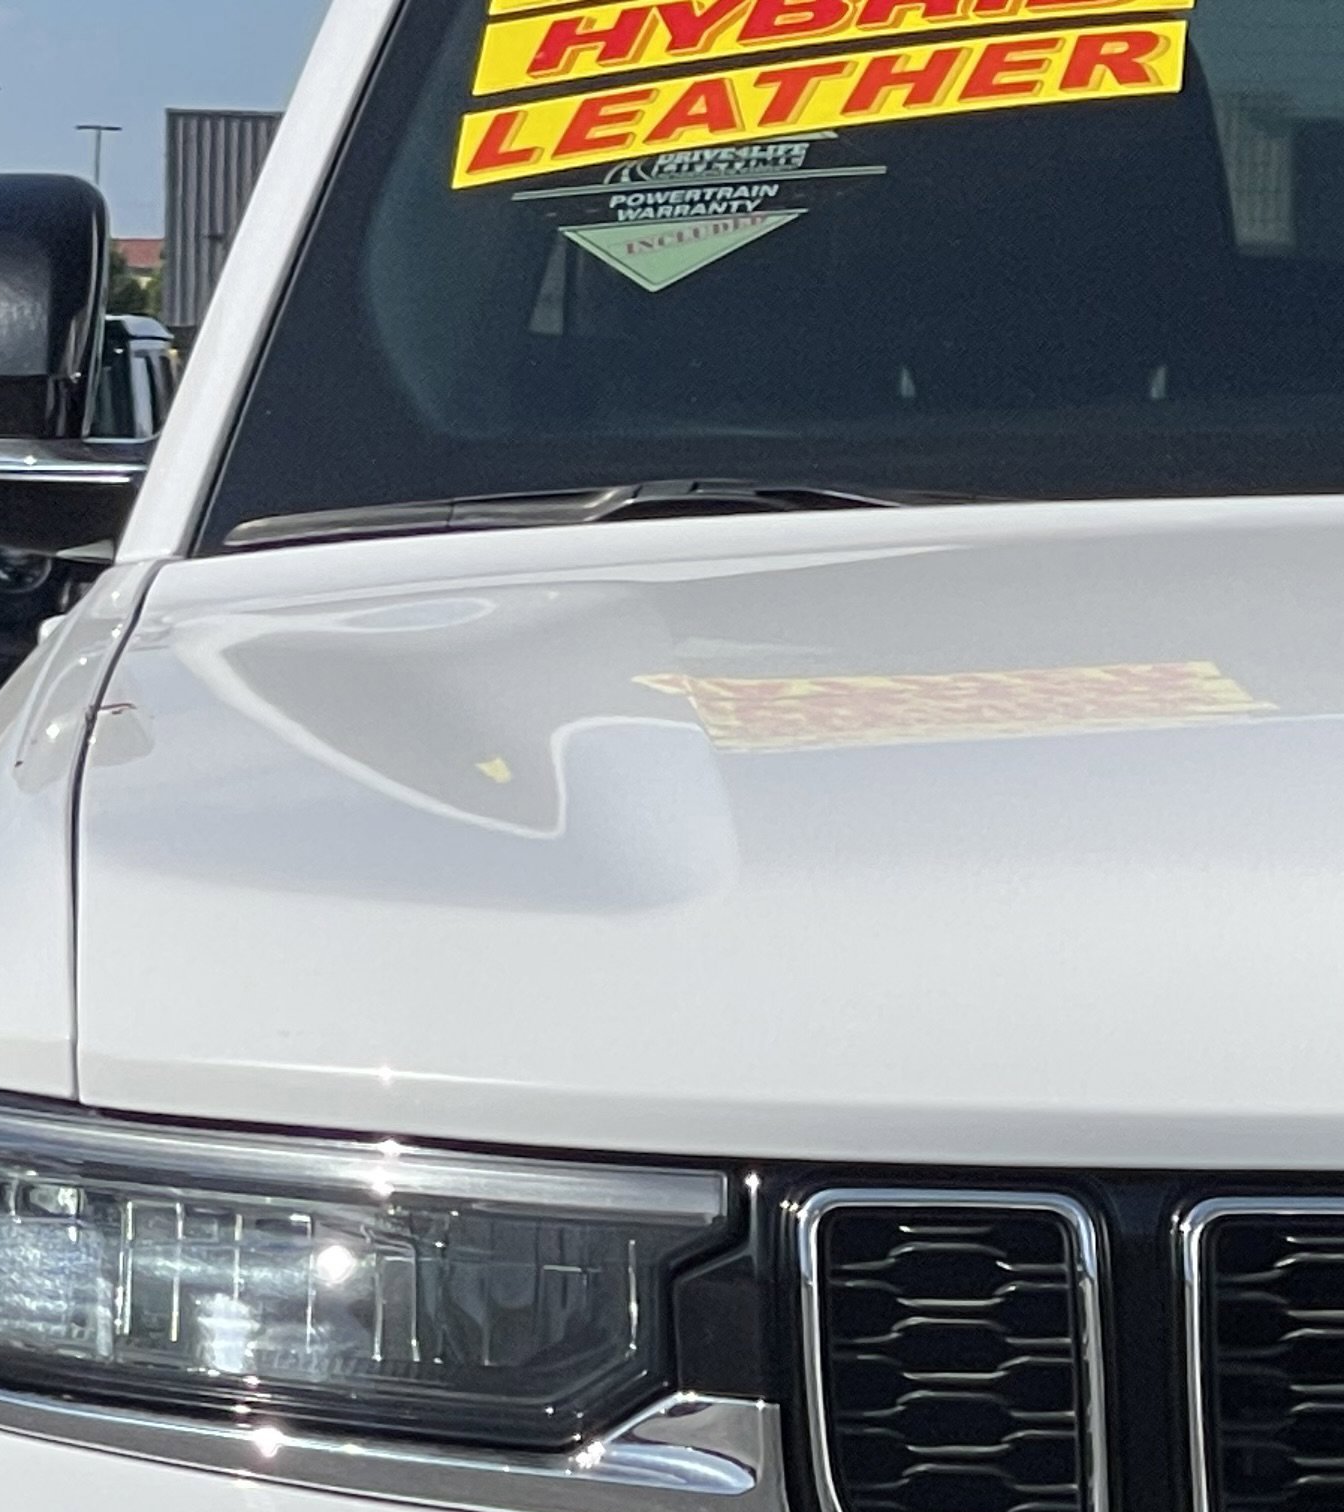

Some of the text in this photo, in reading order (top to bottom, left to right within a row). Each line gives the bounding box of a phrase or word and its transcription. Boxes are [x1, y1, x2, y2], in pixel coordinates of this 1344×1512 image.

[466, 31, 1170, 176] LEATHER
[609, 184, 779, 208] POWERTRAIN
[617, 199, 763, 222] WARRANTY
